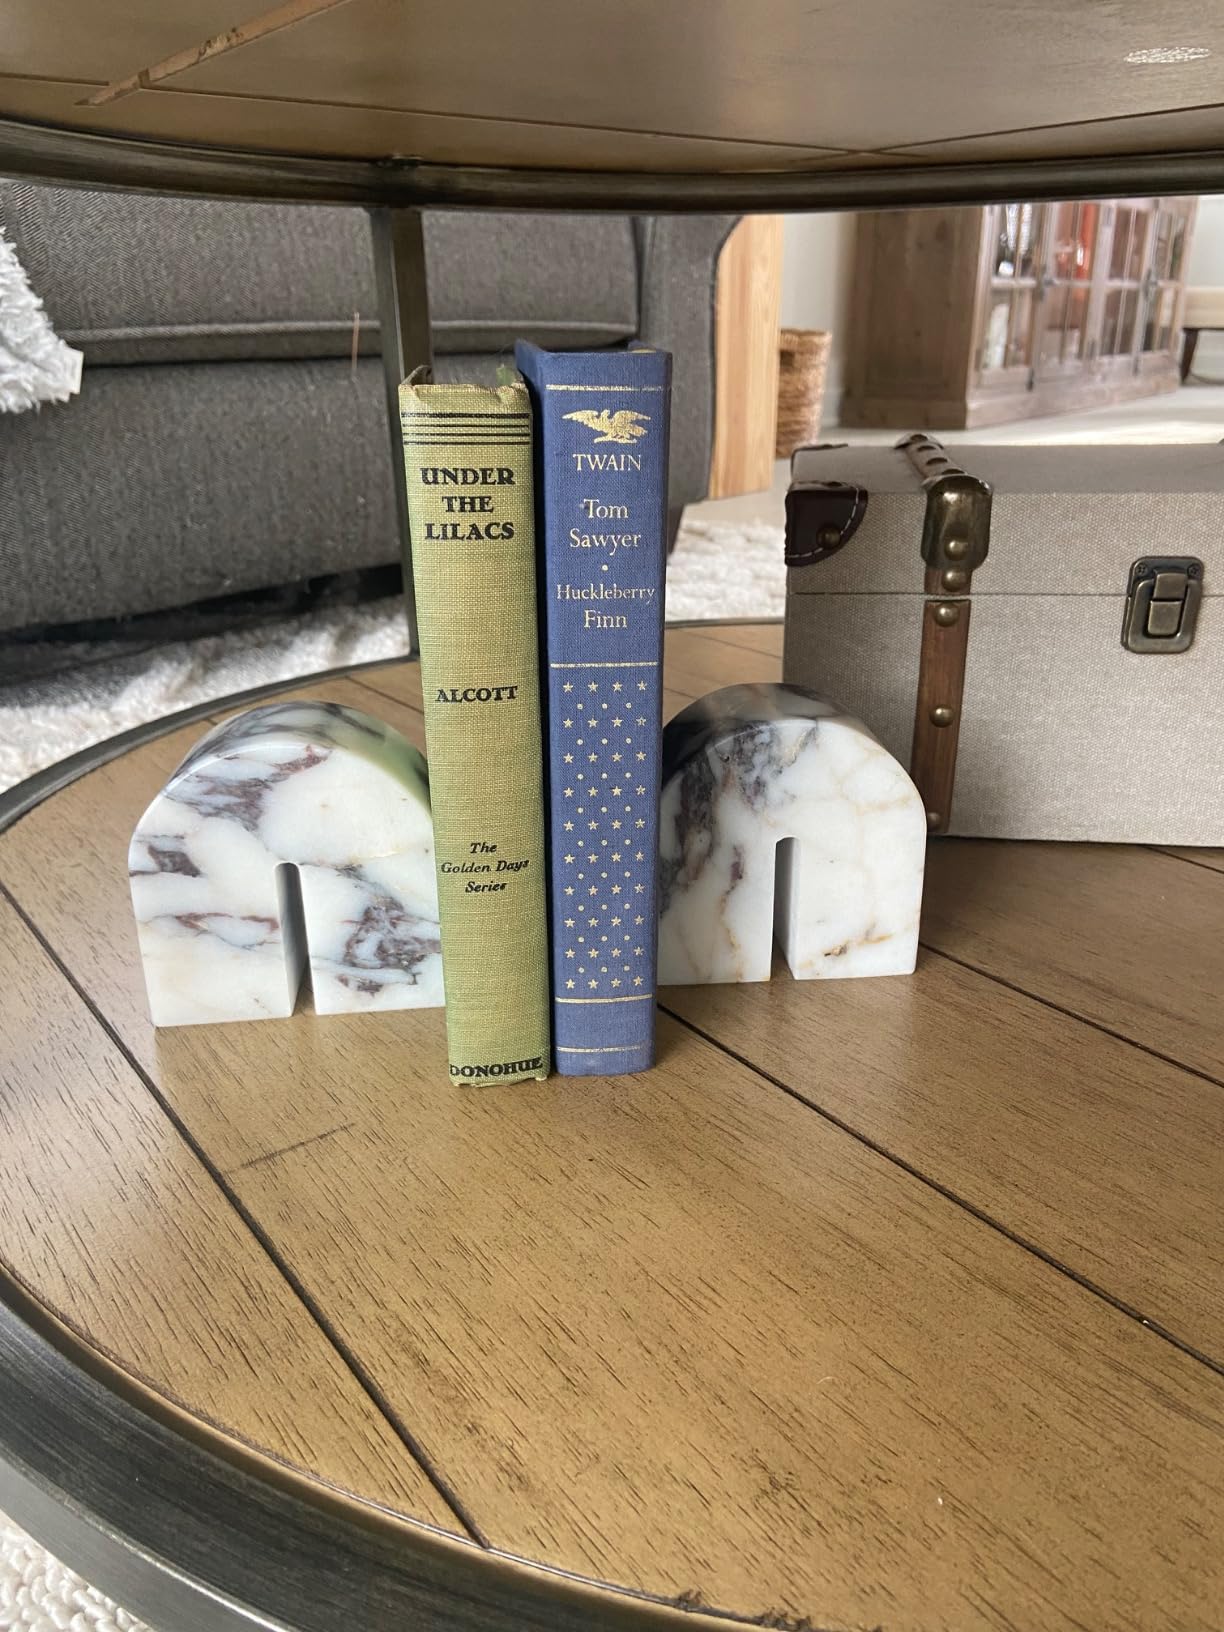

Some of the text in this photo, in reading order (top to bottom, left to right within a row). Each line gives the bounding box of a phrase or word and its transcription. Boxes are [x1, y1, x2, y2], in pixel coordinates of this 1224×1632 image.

[573, 454, 641, 471] TWAIN
[420, 467, 516, 485] UNDER
[442, 496, 494, 513] THE
[583, 498, 629, 519] Tom
[424, 522, 515, 540] LILACS
[569, 528, 642, 556] Sawyer
[556, 583, 655, 604] Huckleberry
[583, 609, 628, 628] Finn
[435, 685, 518, 703] ALCOTT
[470, 841, 498, 854] The
[441, 860, 530, 873] Golden Days
[465, 881, 508, 893] Series
[449, 1056, 543, 1077] DONOHUE
